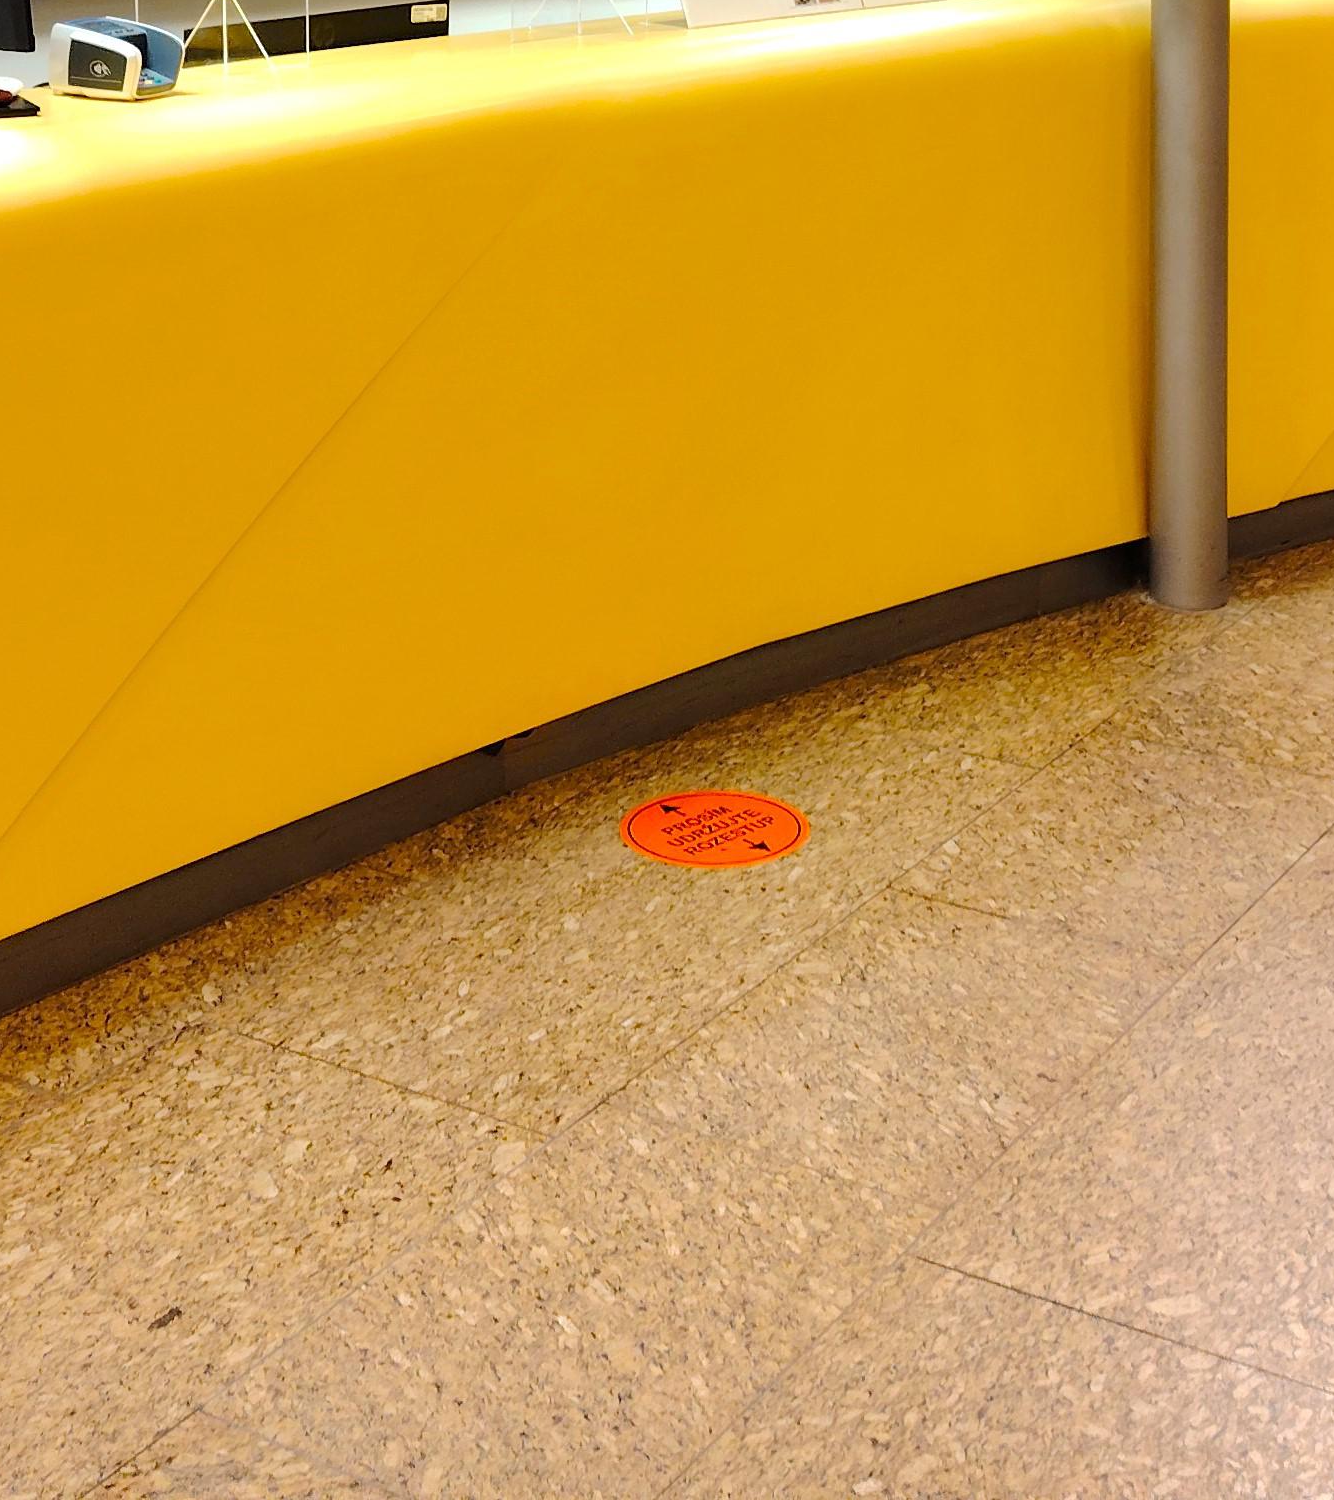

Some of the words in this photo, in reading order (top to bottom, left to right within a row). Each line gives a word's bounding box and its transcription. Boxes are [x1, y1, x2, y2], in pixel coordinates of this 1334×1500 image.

[661, 804, 733, 836] PROSÍM
[667, 808, 763, 848] UDRŽUJTE
[682, 814, 776, 857] ROZESTUP
